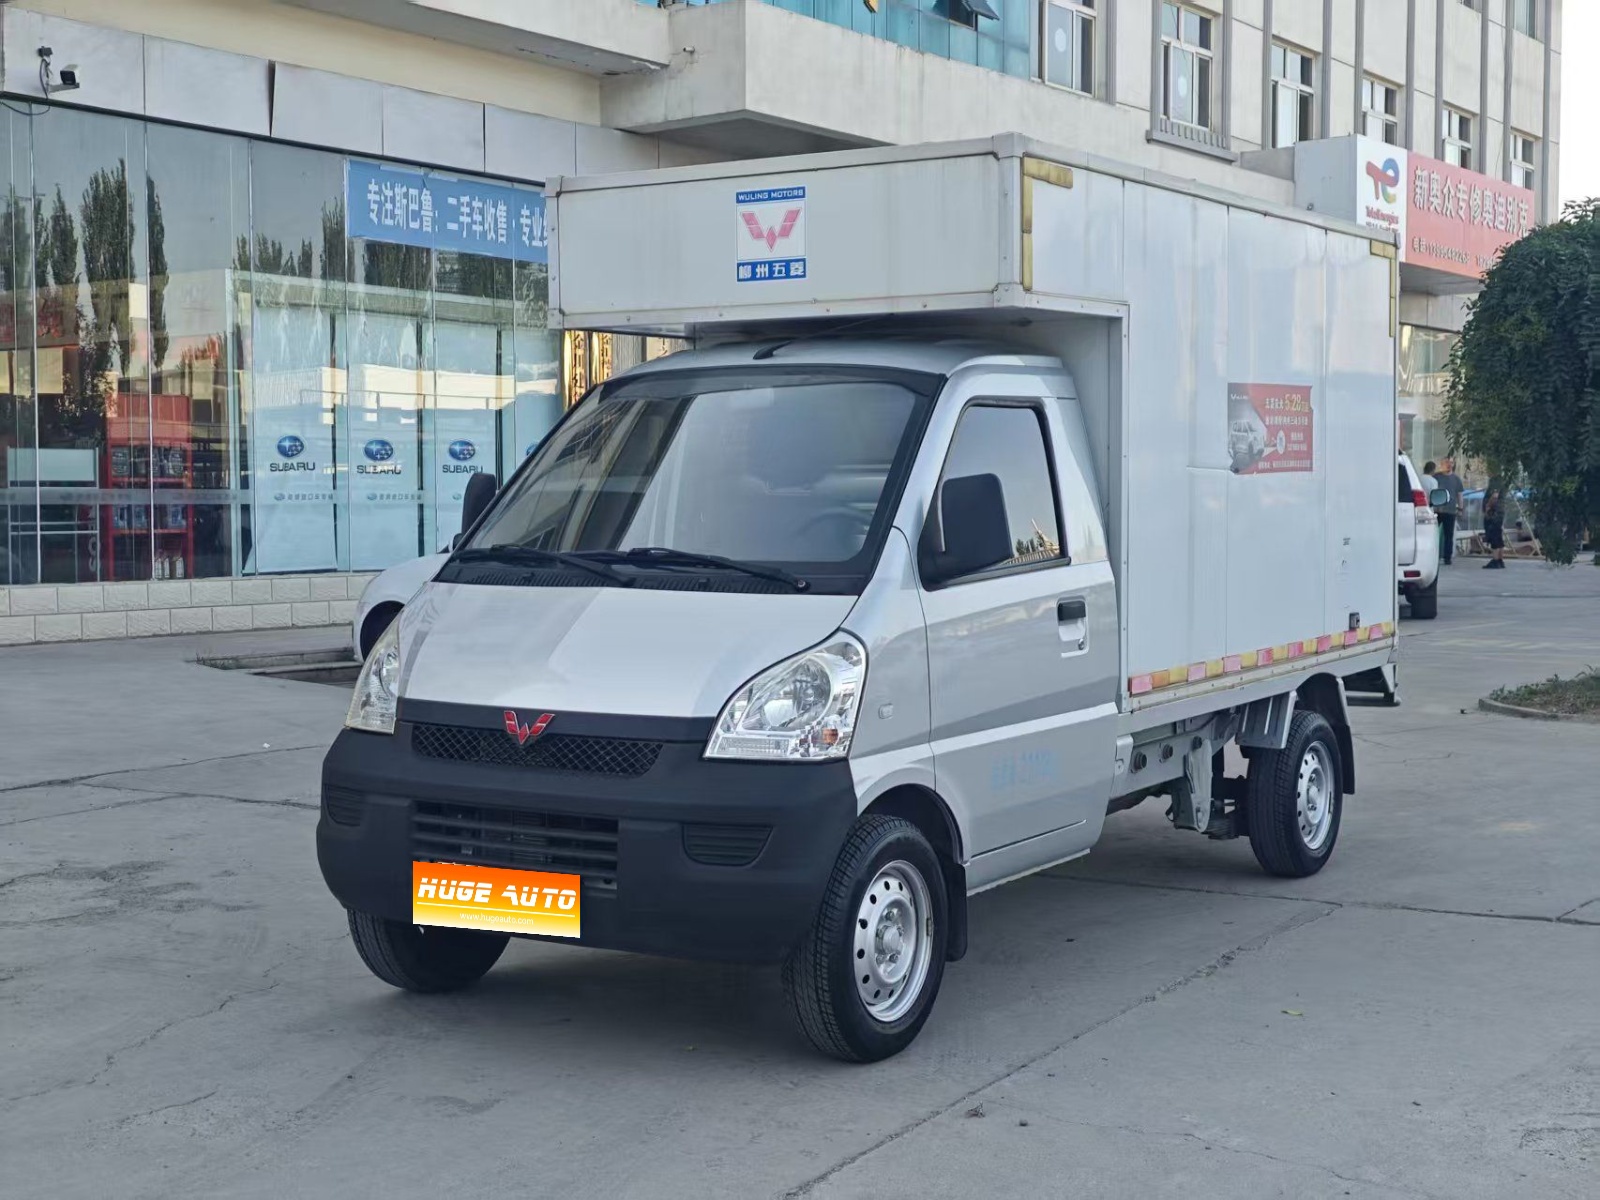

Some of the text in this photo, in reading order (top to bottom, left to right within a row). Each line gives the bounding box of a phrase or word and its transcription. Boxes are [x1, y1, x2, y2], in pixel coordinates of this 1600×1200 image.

[738, 189, 803, 201] WULING MOTORS
[269, 461, 316, 472] SUBARU
[442, 464, 483, 473] SUBARU
